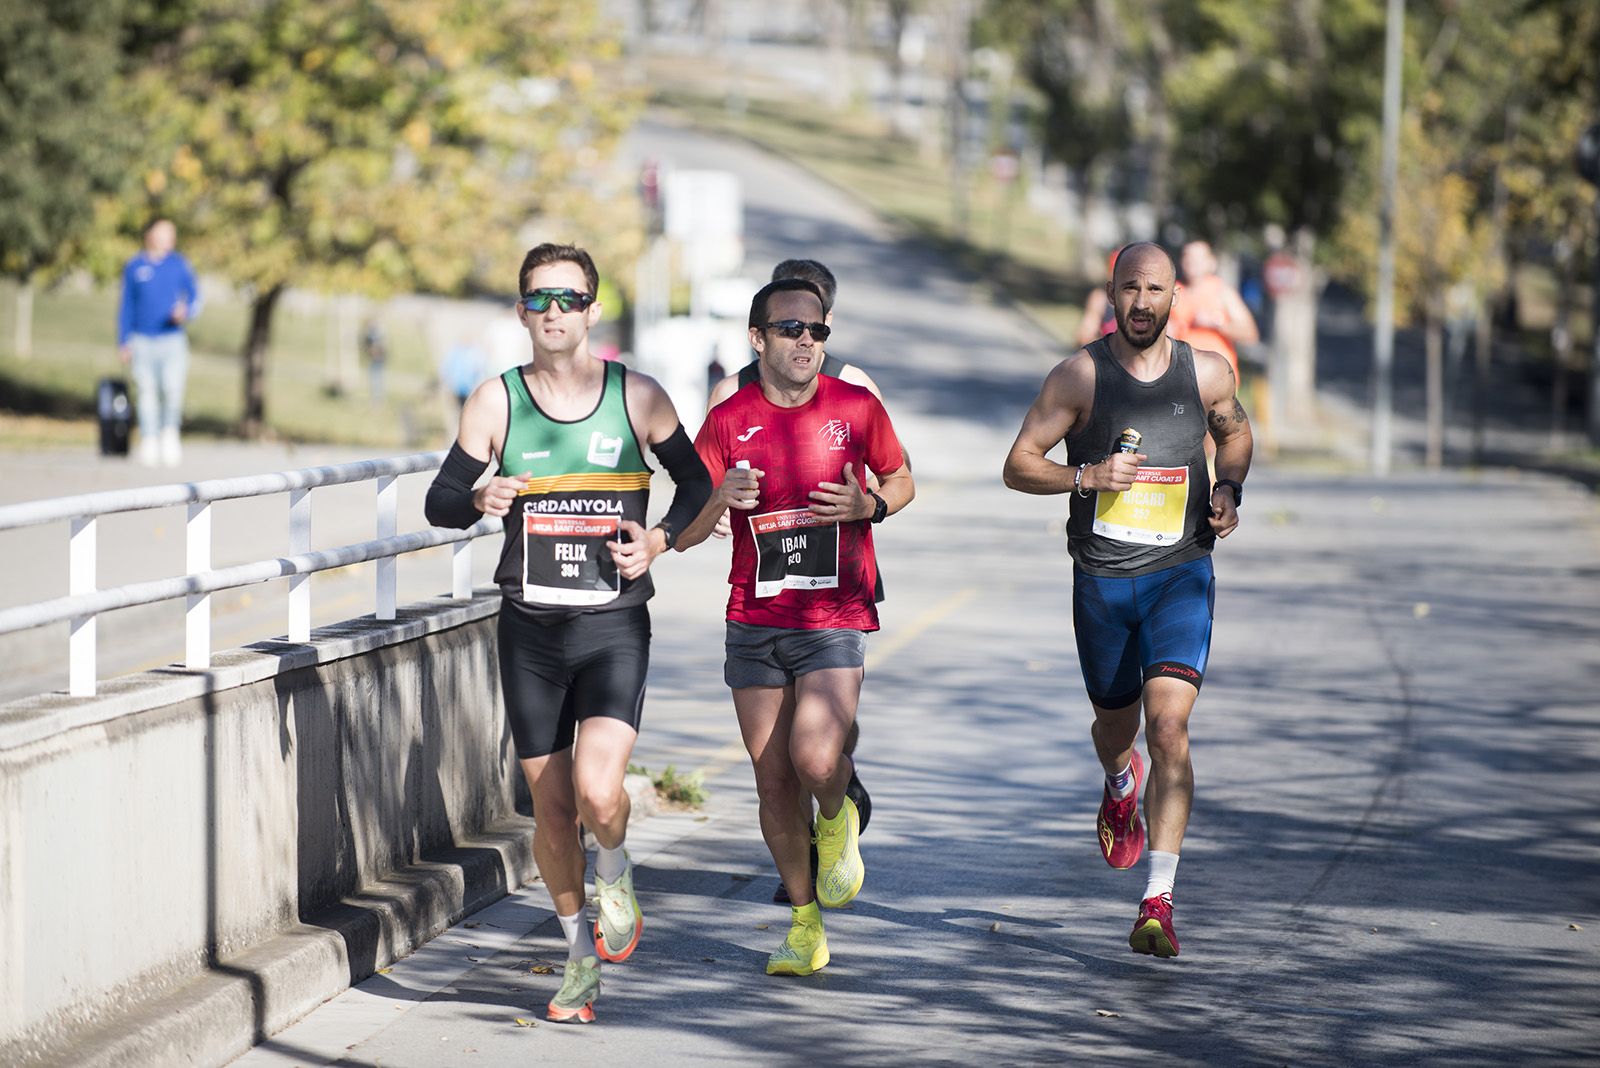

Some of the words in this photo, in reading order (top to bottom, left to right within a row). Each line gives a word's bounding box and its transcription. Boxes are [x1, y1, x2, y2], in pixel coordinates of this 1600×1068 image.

[1123, 490, 1166, 508] RICARD
[553, 524, 574, 533] SANT
[574, 525, 601, 533] CUGAT
[777, 519, 796, 528] SANT
[796, 517, 817, 526] CUGA
[554, 543, 588, 562] FELIX
[781, 534, 807, 554] IBAN
